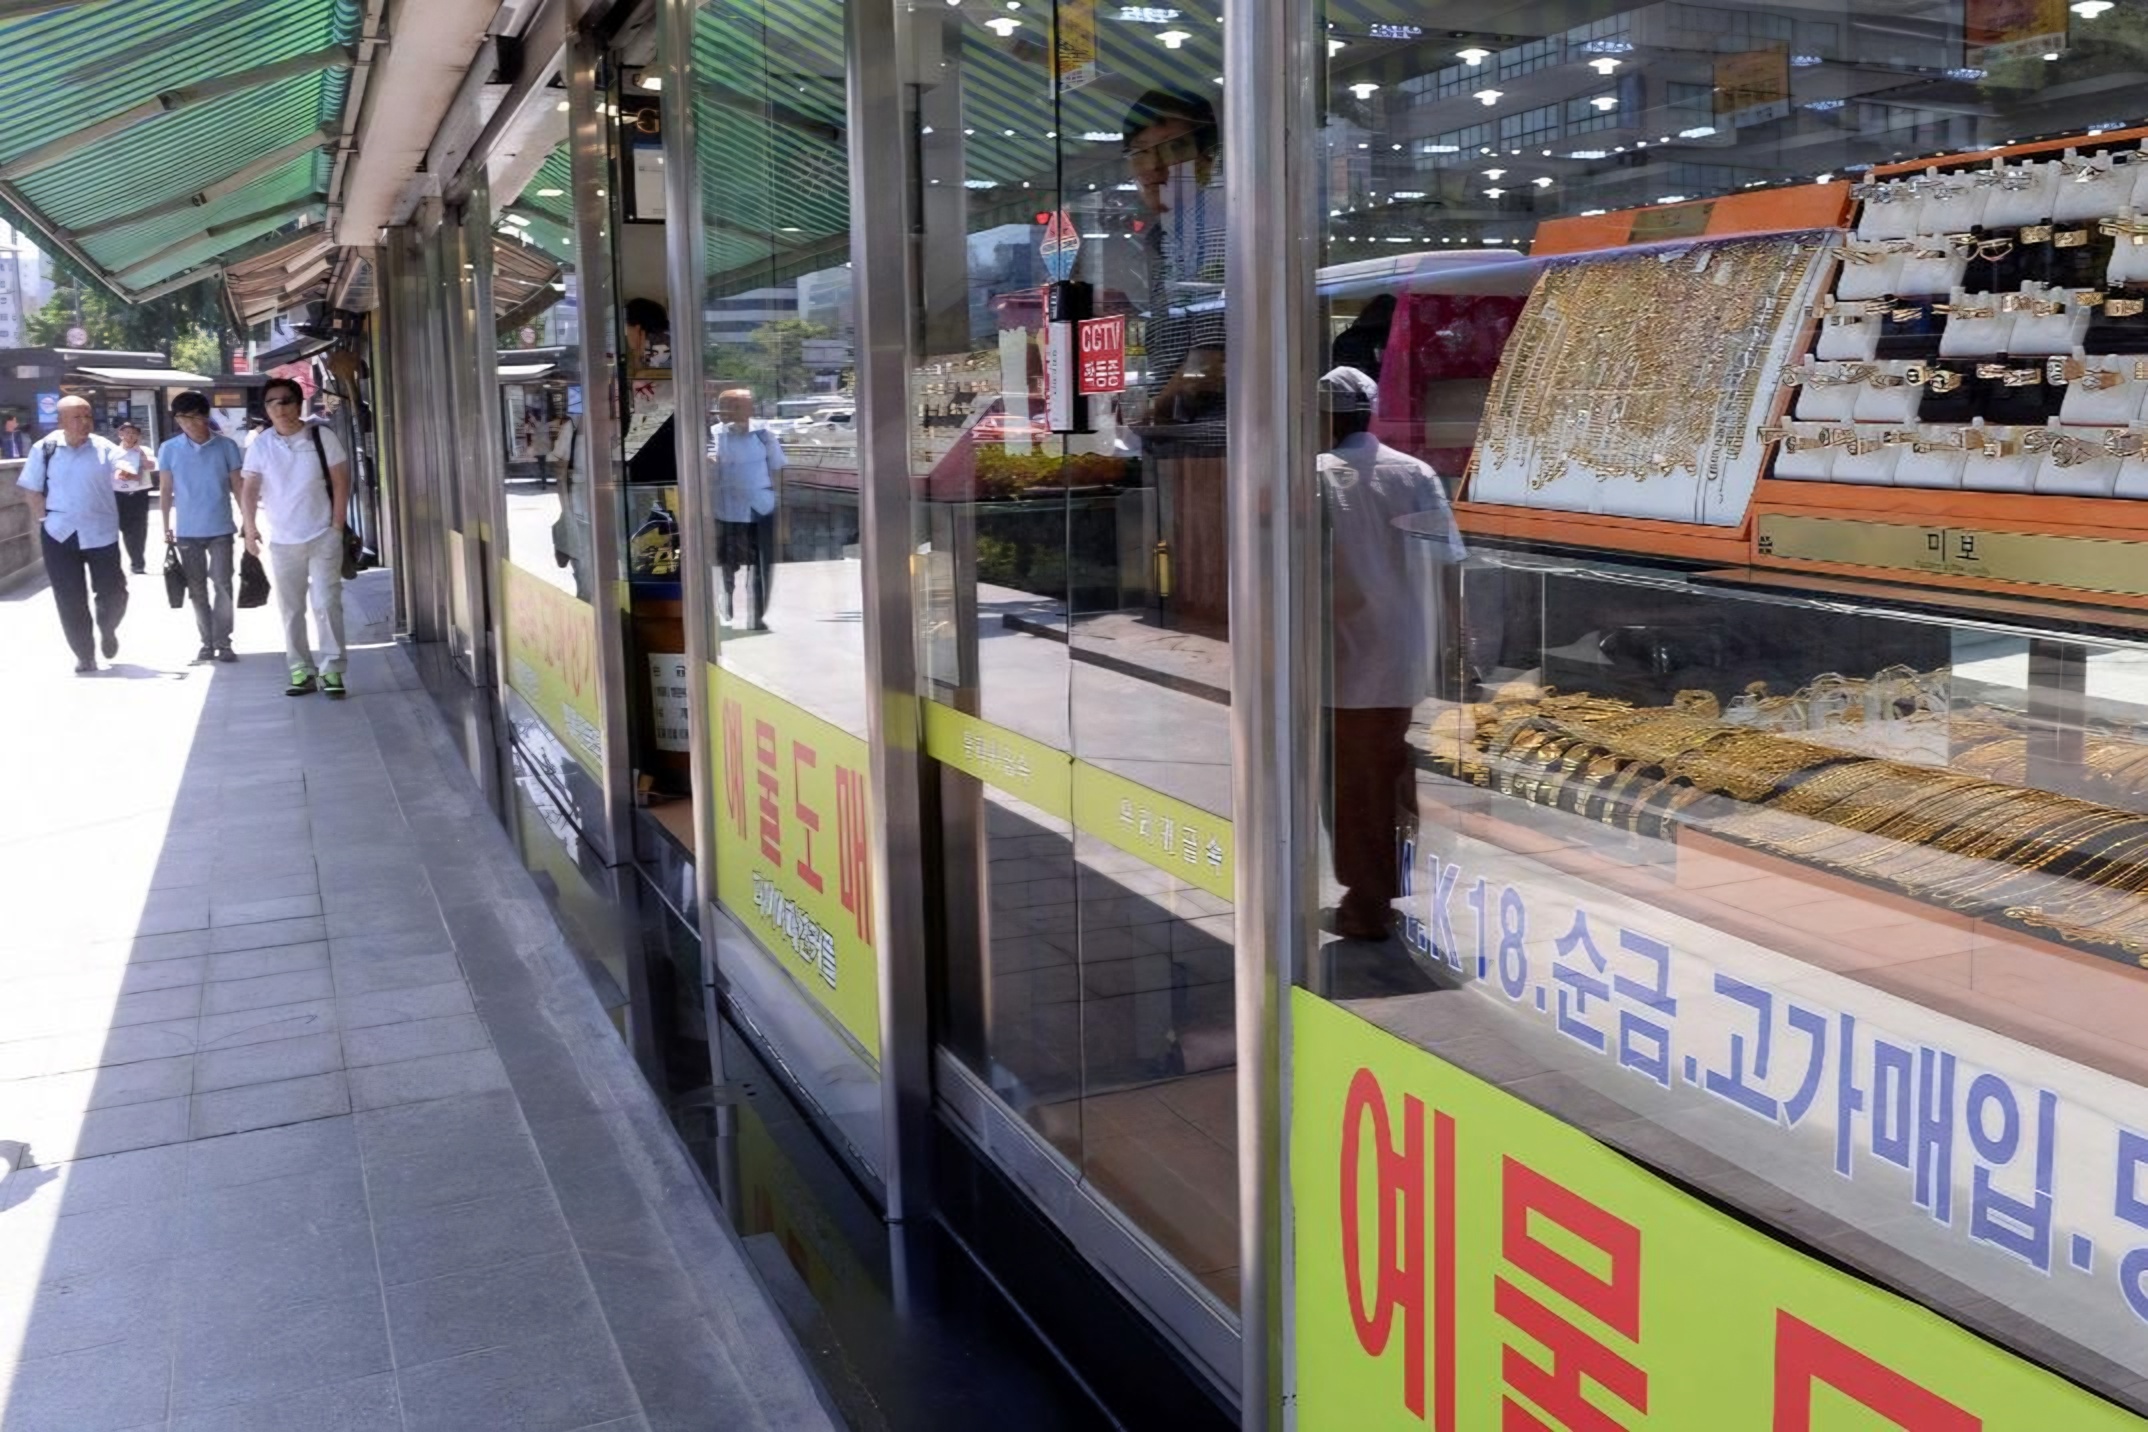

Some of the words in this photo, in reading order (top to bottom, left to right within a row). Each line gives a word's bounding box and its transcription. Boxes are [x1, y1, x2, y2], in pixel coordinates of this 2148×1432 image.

[1082, 321, 1120, 352] CCTV
[1927, 528, 1980, 561] 미보
[722, 697, 873, 948] 예물도매
